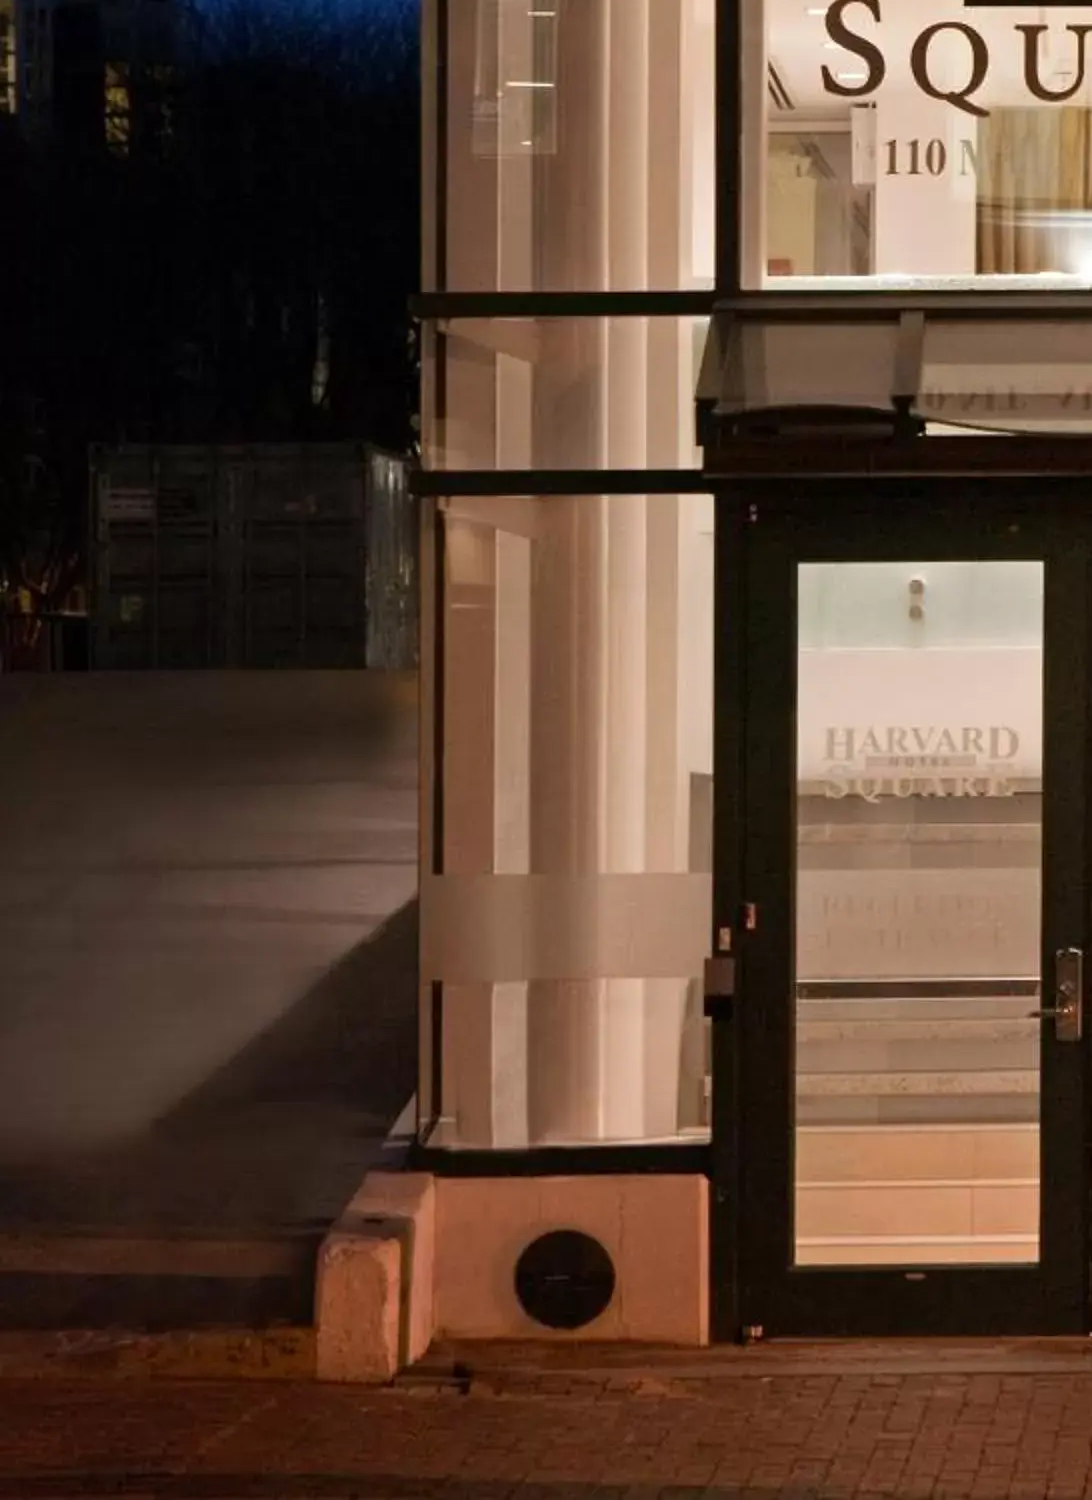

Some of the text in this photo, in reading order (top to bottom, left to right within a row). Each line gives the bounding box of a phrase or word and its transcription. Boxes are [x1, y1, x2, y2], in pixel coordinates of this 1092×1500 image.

[885, 138, 946, 177] 110
[823, 726, 1020, 761] HARVARD
[825, 763, 1016, 803] SQUARE
